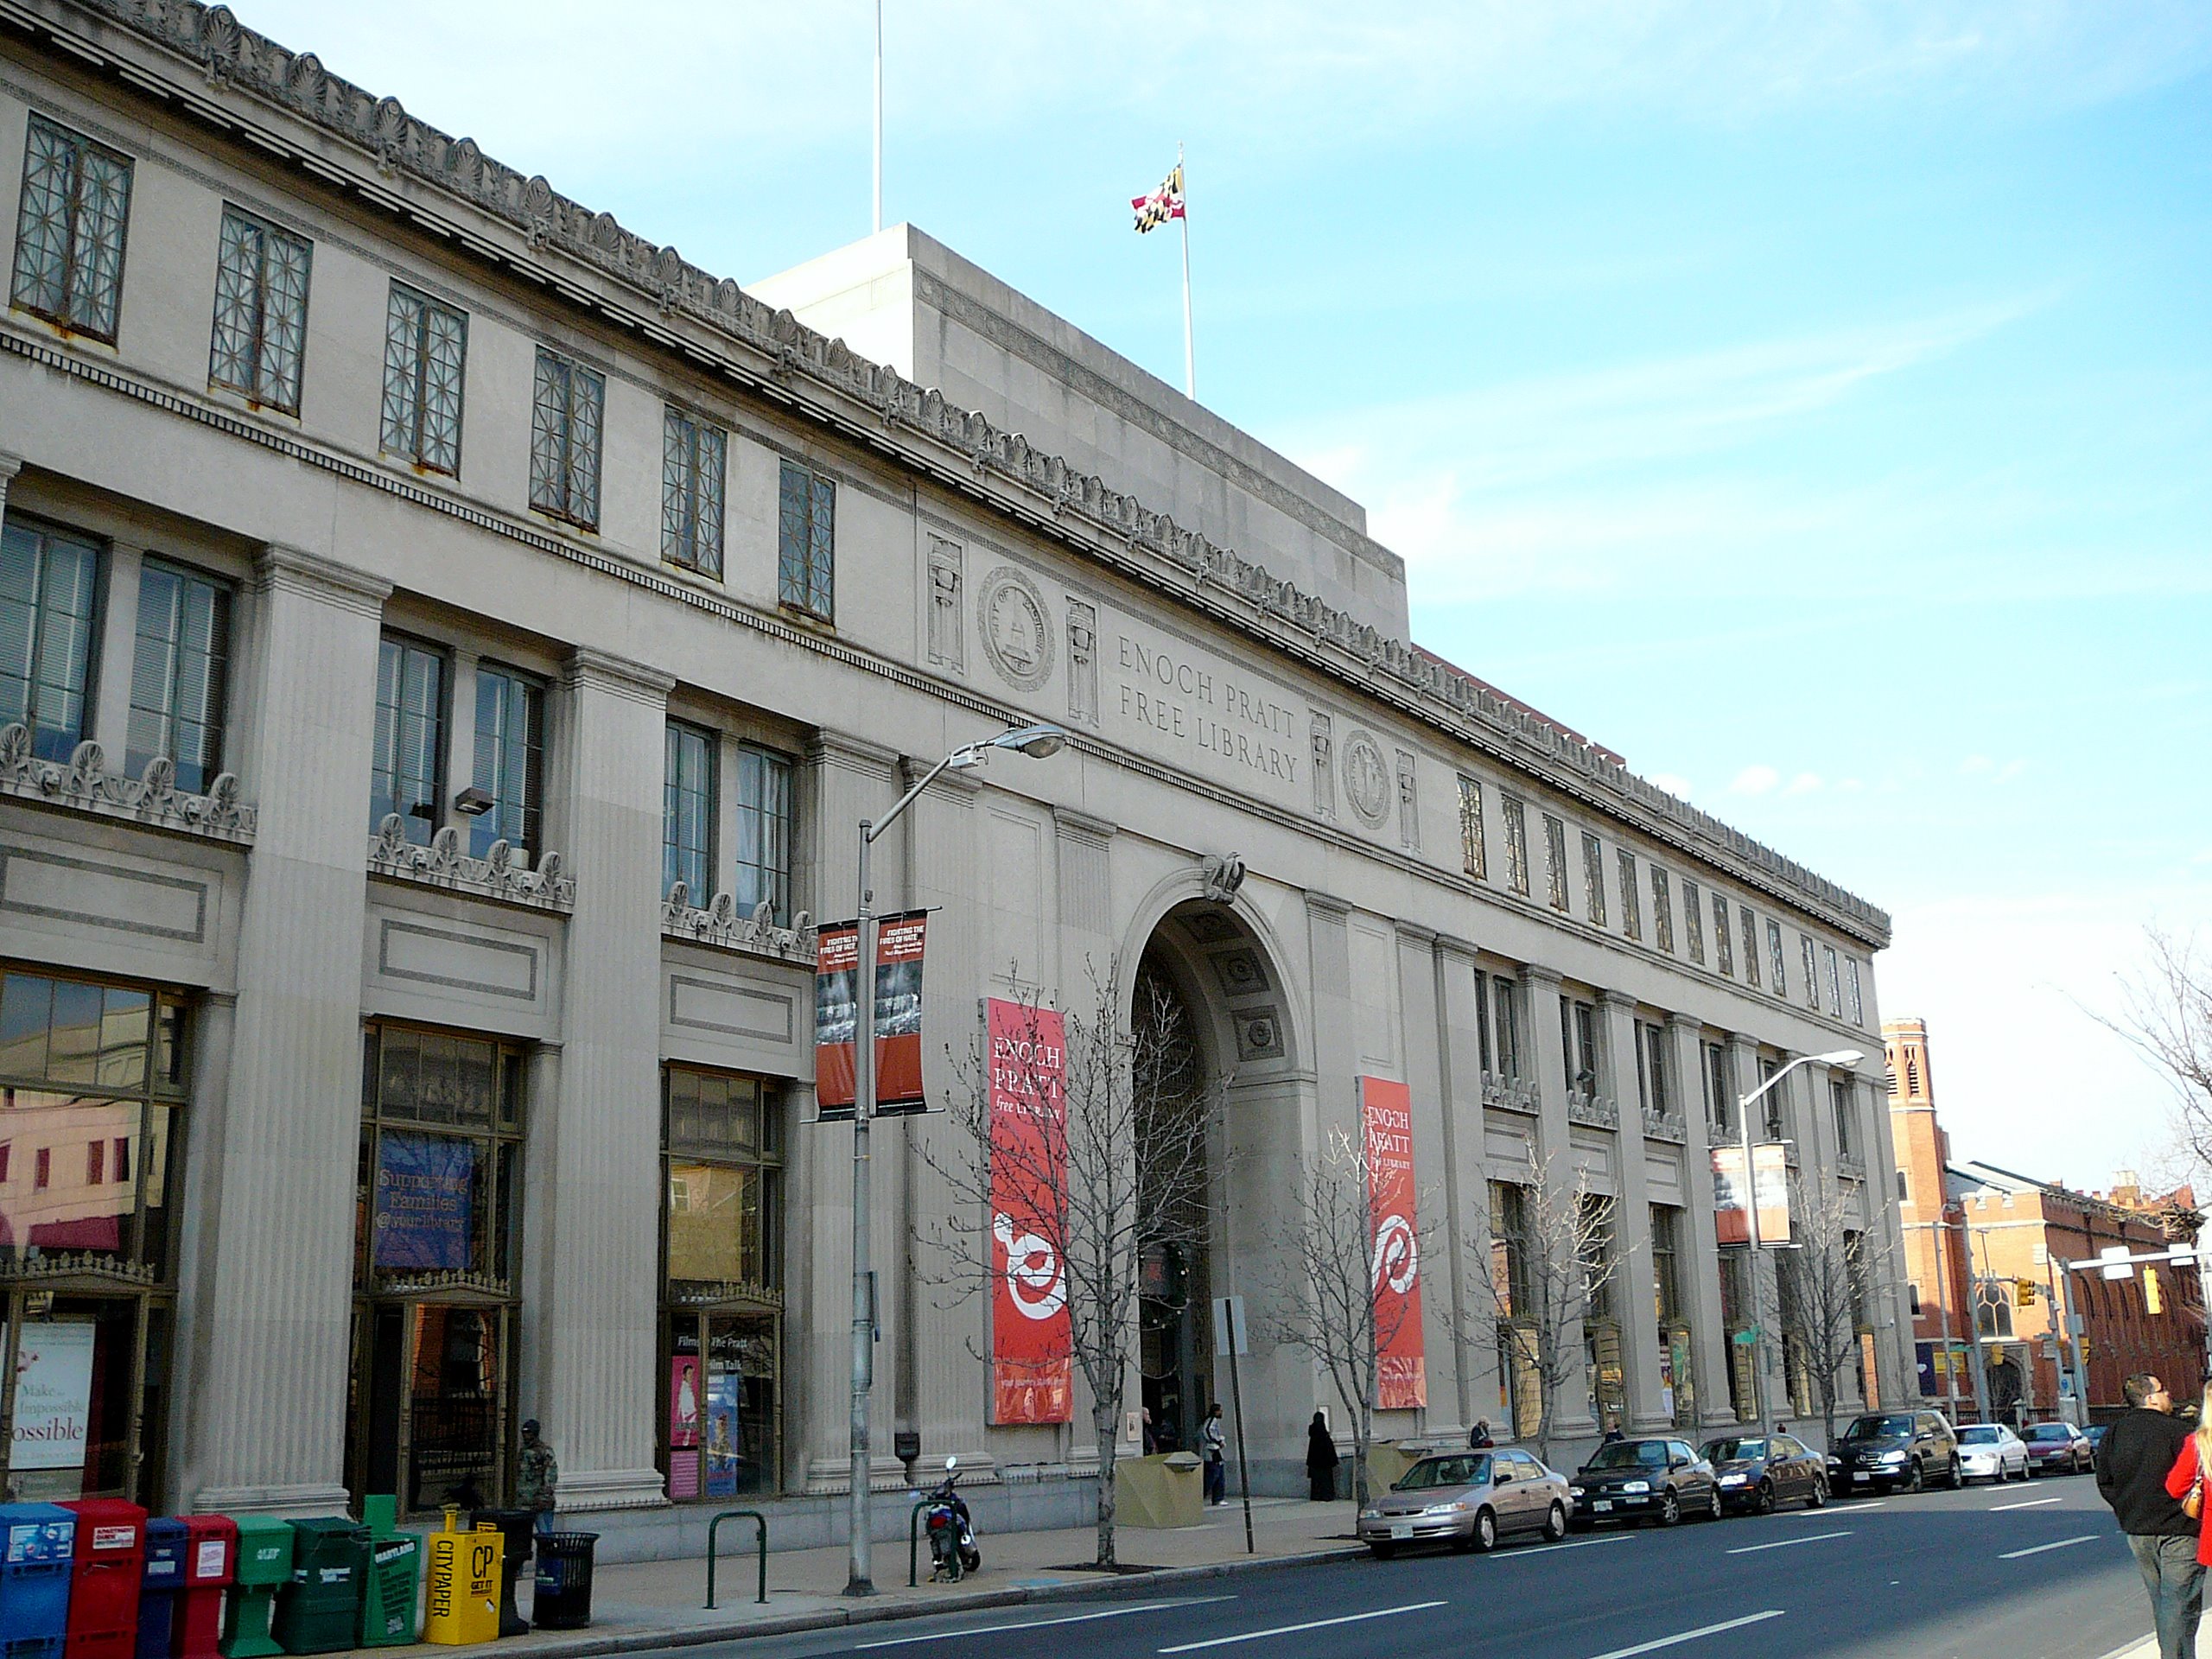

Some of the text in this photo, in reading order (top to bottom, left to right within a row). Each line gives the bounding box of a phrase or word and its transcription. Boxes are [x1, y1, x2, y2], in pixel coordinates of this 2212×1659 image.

[1118, 635, 1294, 739] ENOCH PRATT
[1120, 684, 1185, 739] FREE
[1197, 717, 1298, 783] LIBRARY
[880, 937, 895, 945] FIRES
[903, 933, 918, 942] HATE
[994, 1037, 1060, 1069] ENOCH
[996, 1095, 1014, 1113] free
[1368, 1106, 1409, 1130] ENOCH
[380, 1168, 467, 1195] Supporting
[389, 1191, 456, 1212] Families
[711, 1337, 727, 1348] The
[728, 1337, 747, 1348] Pratt
[709, 1359, 741, 1370] ilm Talk
[12, 1416, 84, 1442] ossible
[472, 1546, 493, 1579] CP
